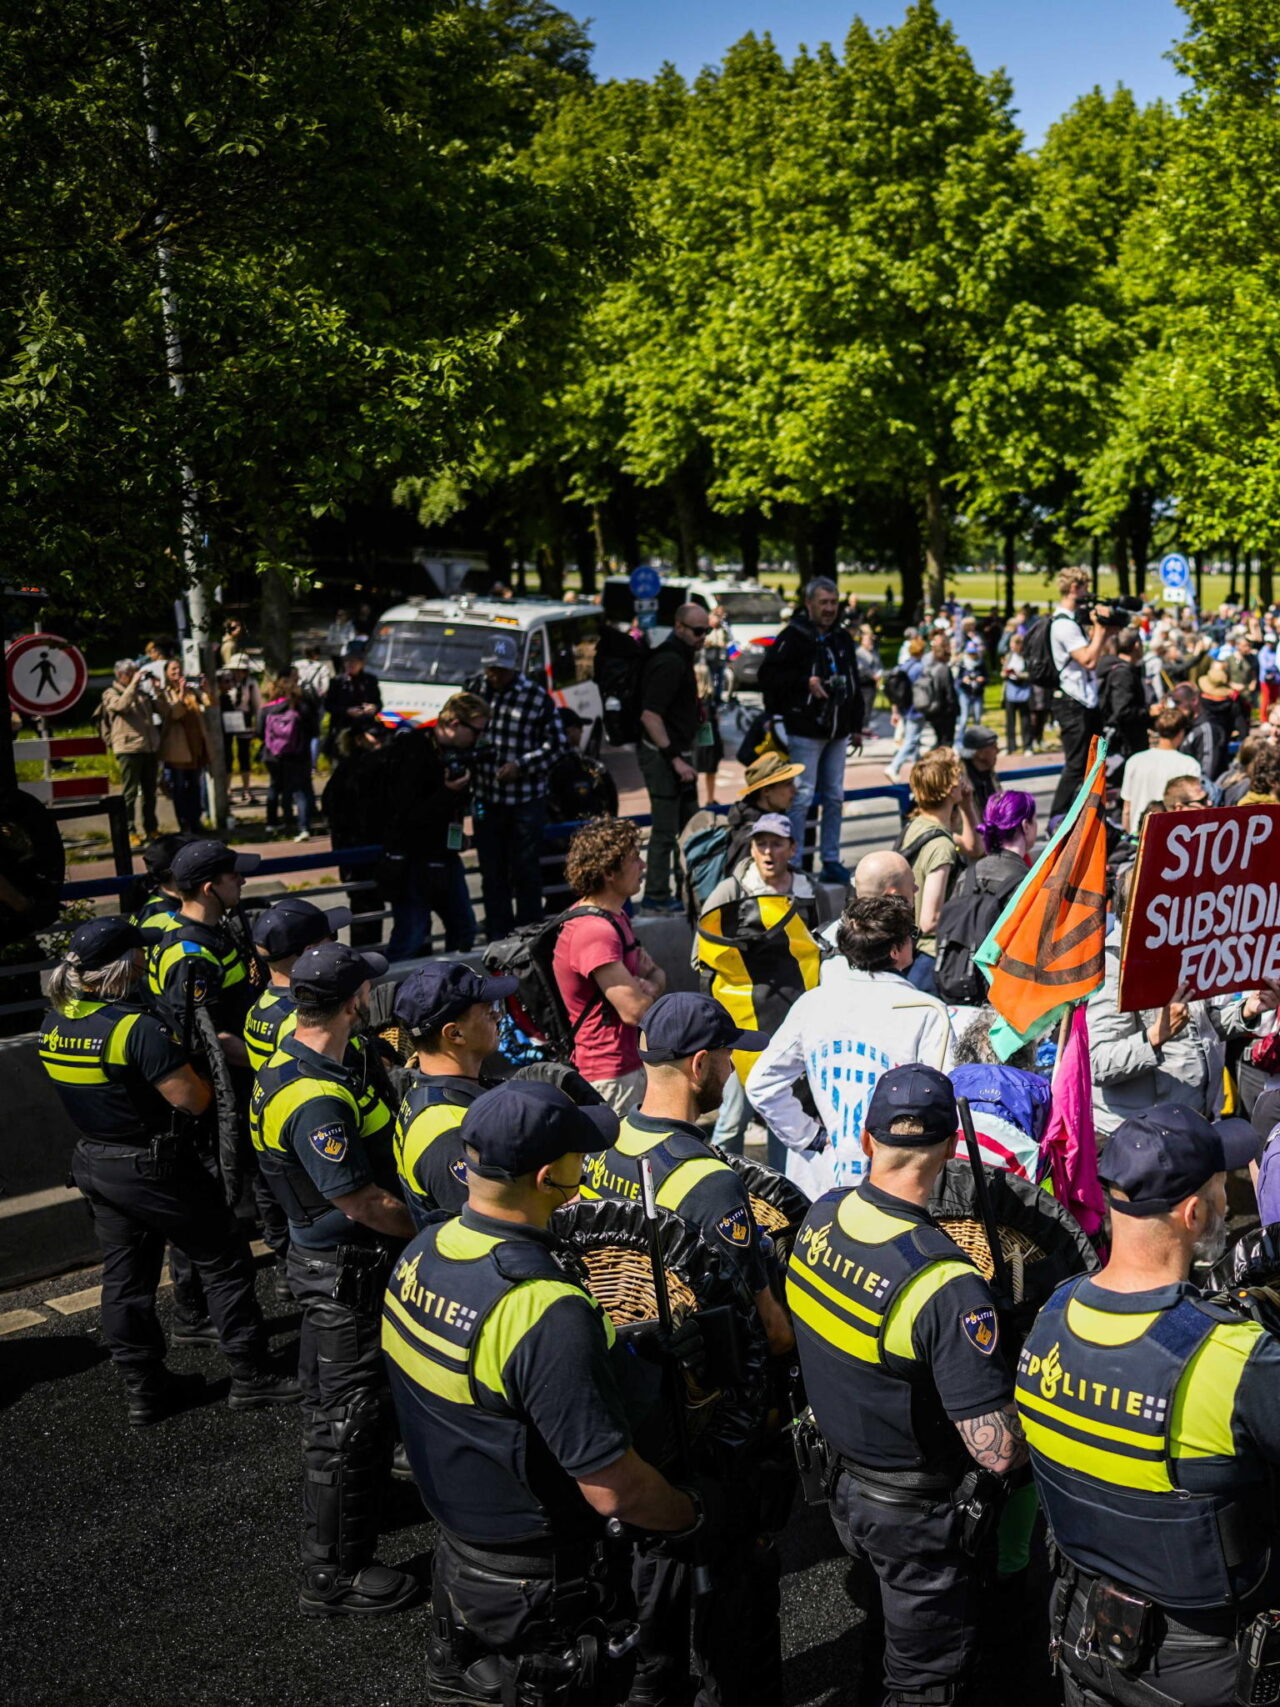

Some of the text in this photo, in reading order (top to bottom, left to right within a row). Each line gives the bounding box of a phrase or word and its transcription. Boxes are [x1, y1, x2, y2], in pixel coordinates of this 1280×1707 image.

[1160, 814, 1273, 881] STOP
[43, 1025, 92, 1052] POLITIE
[587, 1150, 640, 1200] POLITIE
[719, 1209, 744, 1229] POLITIE
[801, 1221, 882, 1294] POLITIE
[396, 1251, 461, 1325] POLITIE
[965, 1310, 994, 1325] POLITIE
[1027, 1341, 1145, 1417] POLITIE
